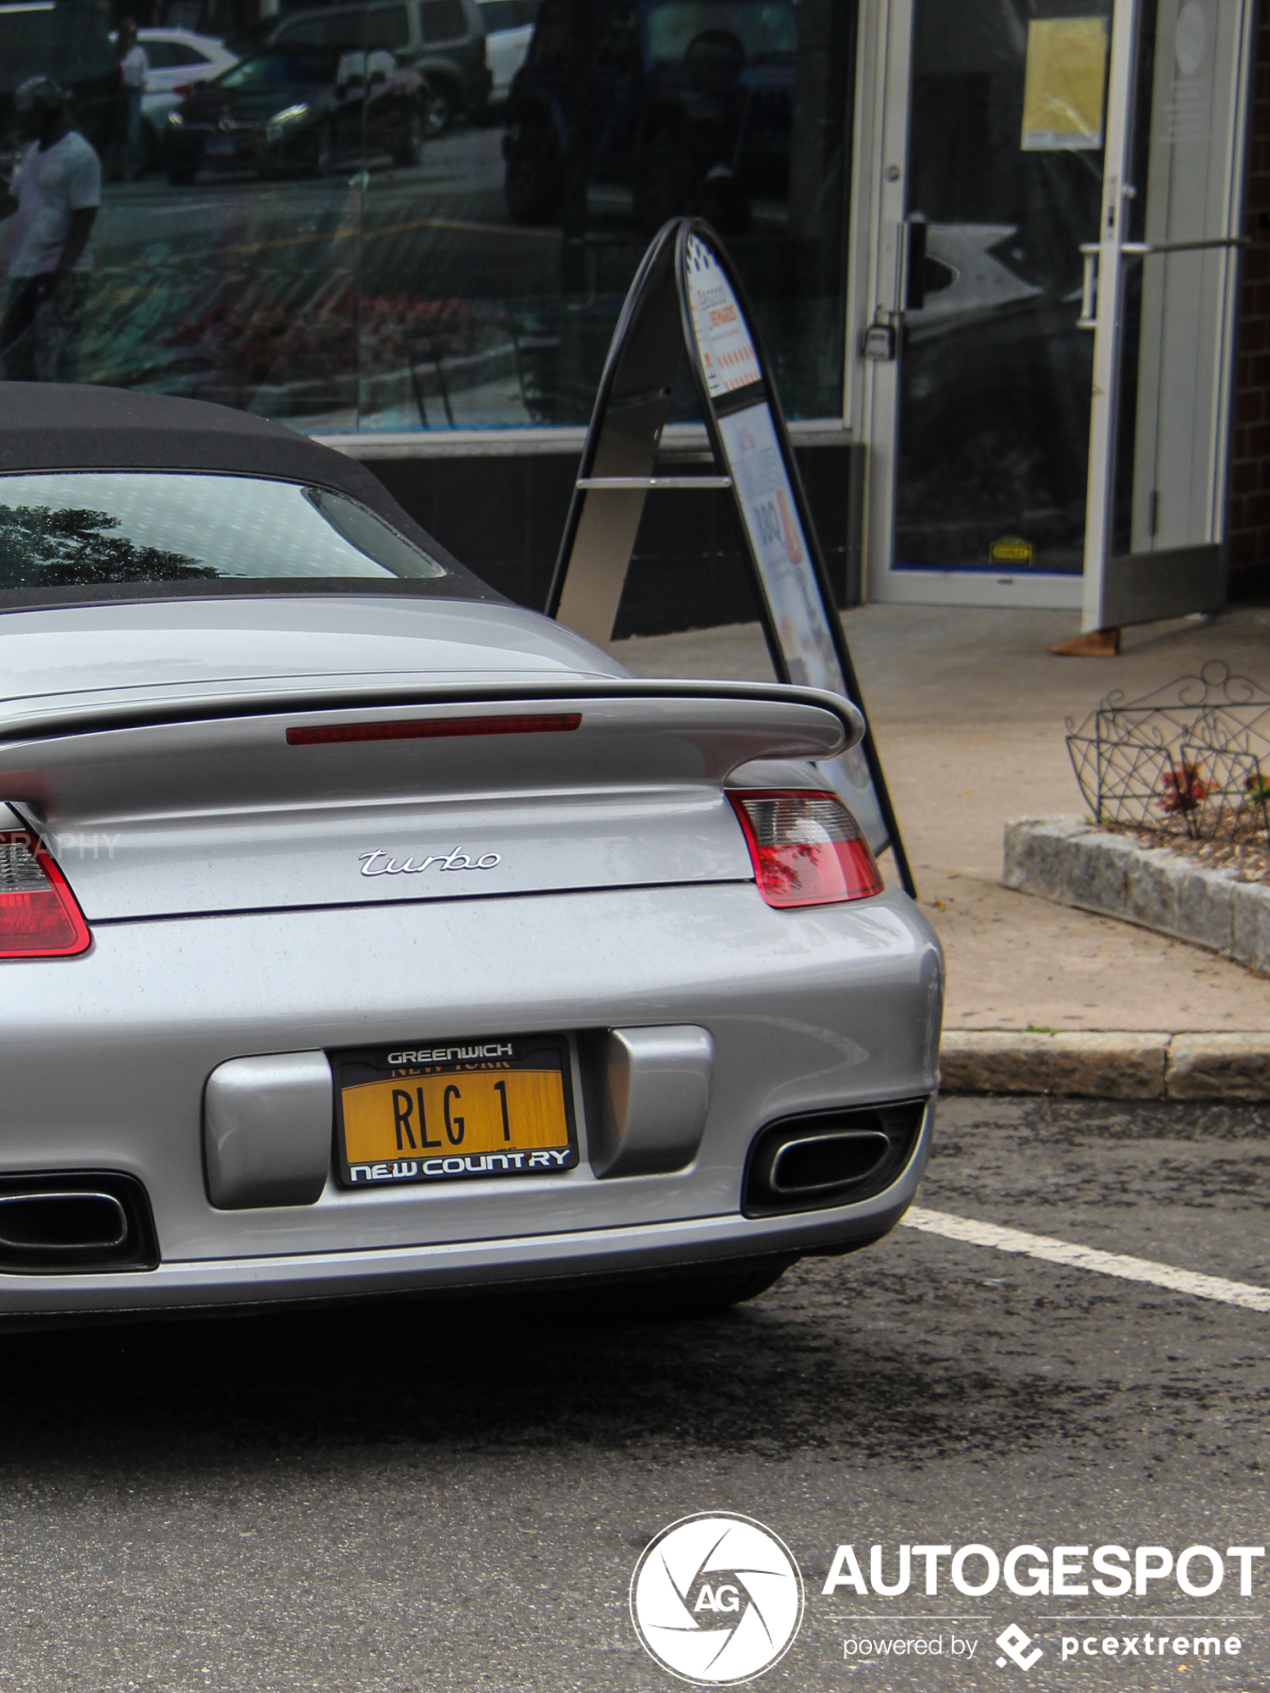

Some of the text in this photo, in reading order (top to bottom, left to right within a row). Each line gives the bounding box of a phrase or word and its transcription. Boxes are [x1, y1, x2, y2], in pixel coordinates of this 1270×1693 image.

[359, 846, 502, 876] turbo
[387, 1043, 513, 1064] GREENWICH
[392, 1080, 510, 1150] RLG 1
[350, 1162, 417, 1182] NEW
[423, 1149, 570, 1175] COUNTRY
